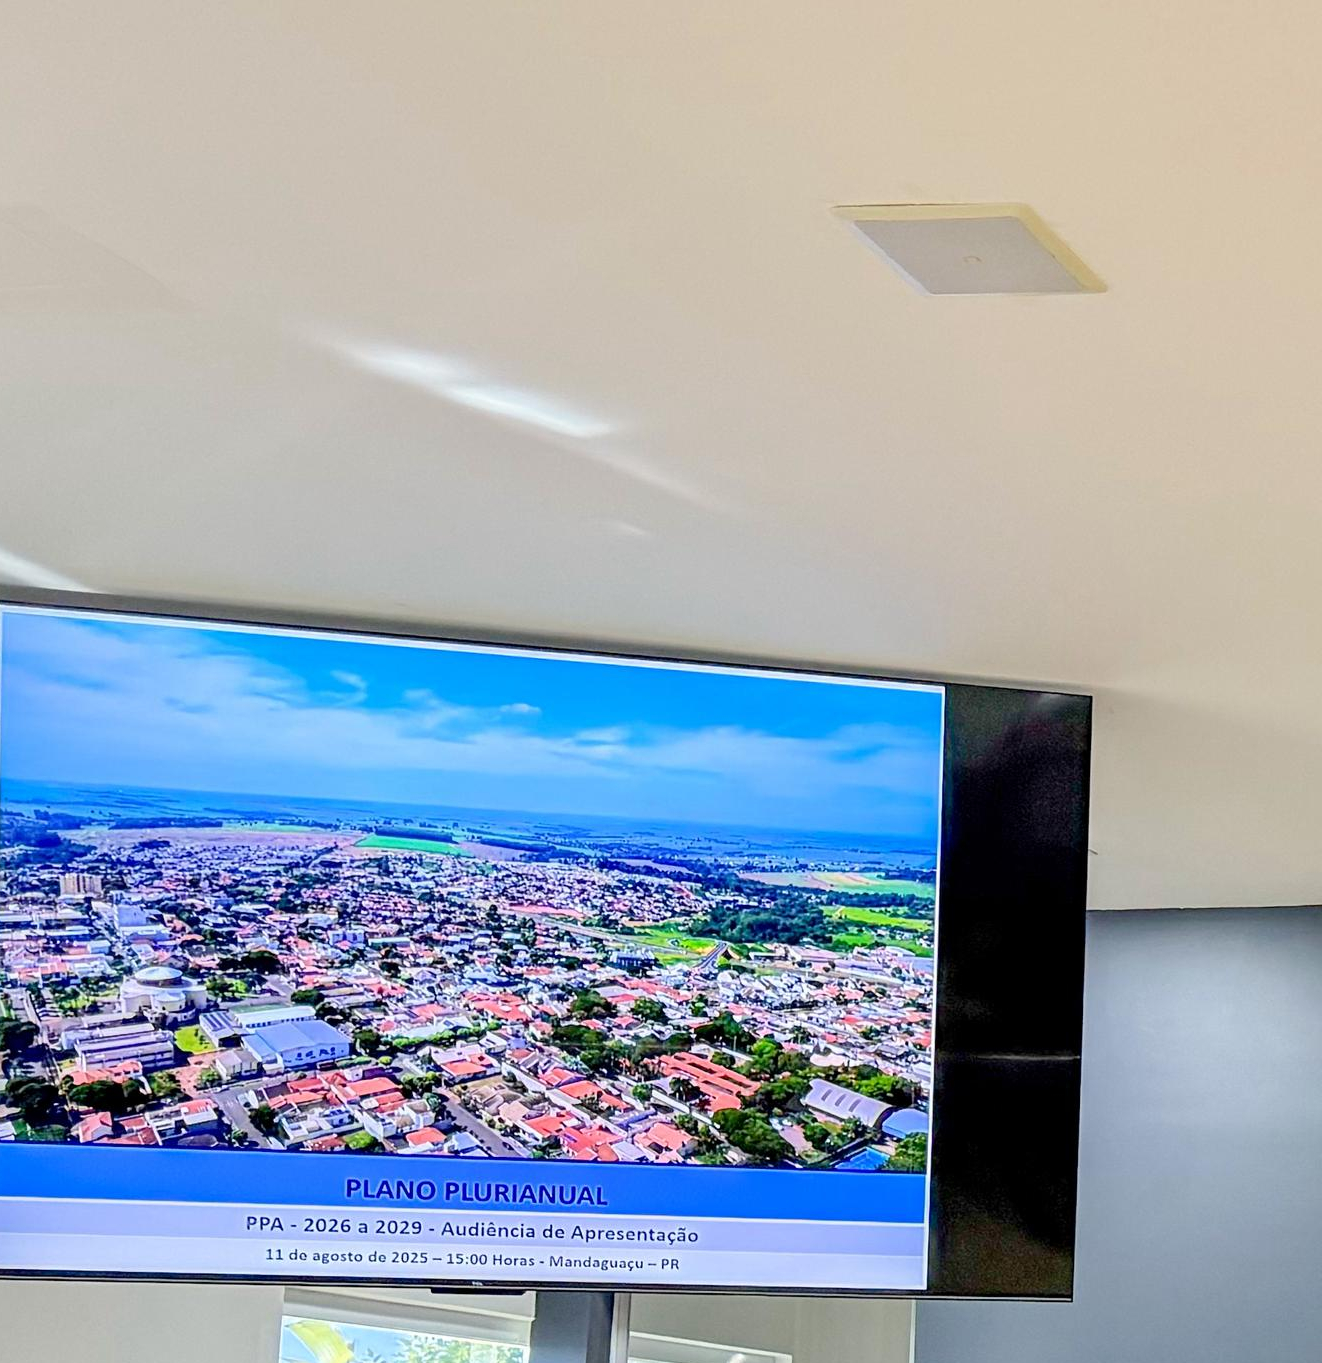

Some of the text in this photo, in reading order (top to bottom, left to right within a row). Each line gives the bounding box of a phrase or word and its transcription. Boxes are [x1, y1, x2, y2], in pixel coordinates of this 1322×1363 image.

[346, 1179, 608, 1206] PLANO PLURIANUAL
[246, 1216, 284, 1232] PPA
[304, 1218, 351, 1233] 2026
[358, 1222, 369, 1234] a
[375, 1220, 422, 1235] 2029
[441, 1222, 535, 1239] Audiência
[542, 1224, 565, 1239] de
[571, 1225, 699, 1246] Apresentação
[265, 1249, 284, 1261] 11
[289, 1249, 307, 1261] de
[312, 1251, 363, 1265] agosto
[368, 1251, 387, 1263] de
[391, 1252, 428, 1264] 2025
[446, 1253, 488, 1265] 15:00
[492, 1254, 535, 1267] Horas
[549, 1256, 644, 1271] Mandaguaçu
[661, 1258, 680, 1270] PR
